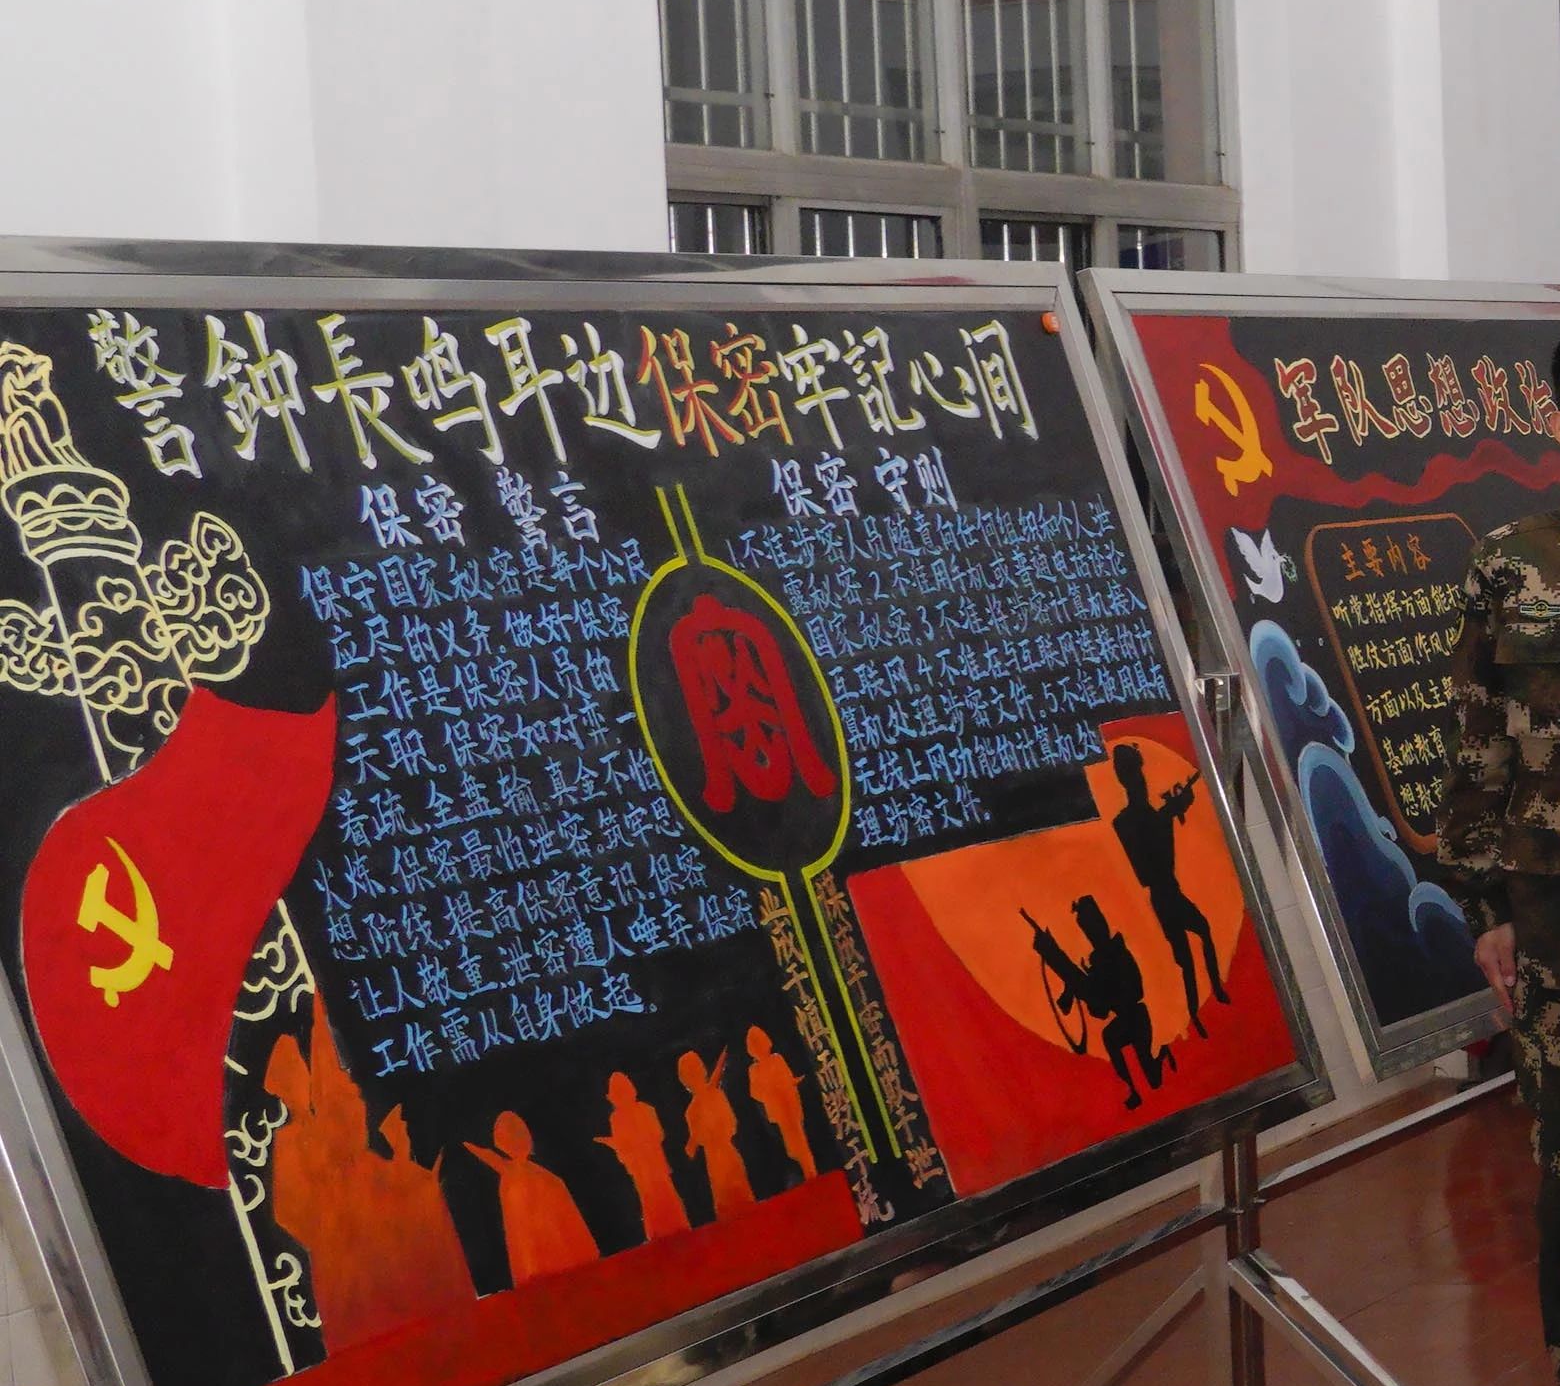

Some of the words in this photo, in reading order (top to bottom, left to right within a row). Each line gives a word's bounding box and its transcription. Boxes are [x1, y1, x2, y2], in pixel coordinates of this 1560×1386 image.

[1274, 350, 1558, 465] 军队思想政治
[772, 446, 959, 517] 保密守则
[301, 538, 653, 622] 保守国家秘密是每个公民
[1341, 533, 1431, 581] 主要内容
[346, 646, 620, 721] 工作是保密人员的
[855, 720, 1102, 795] 无线上网功能的计算机处
